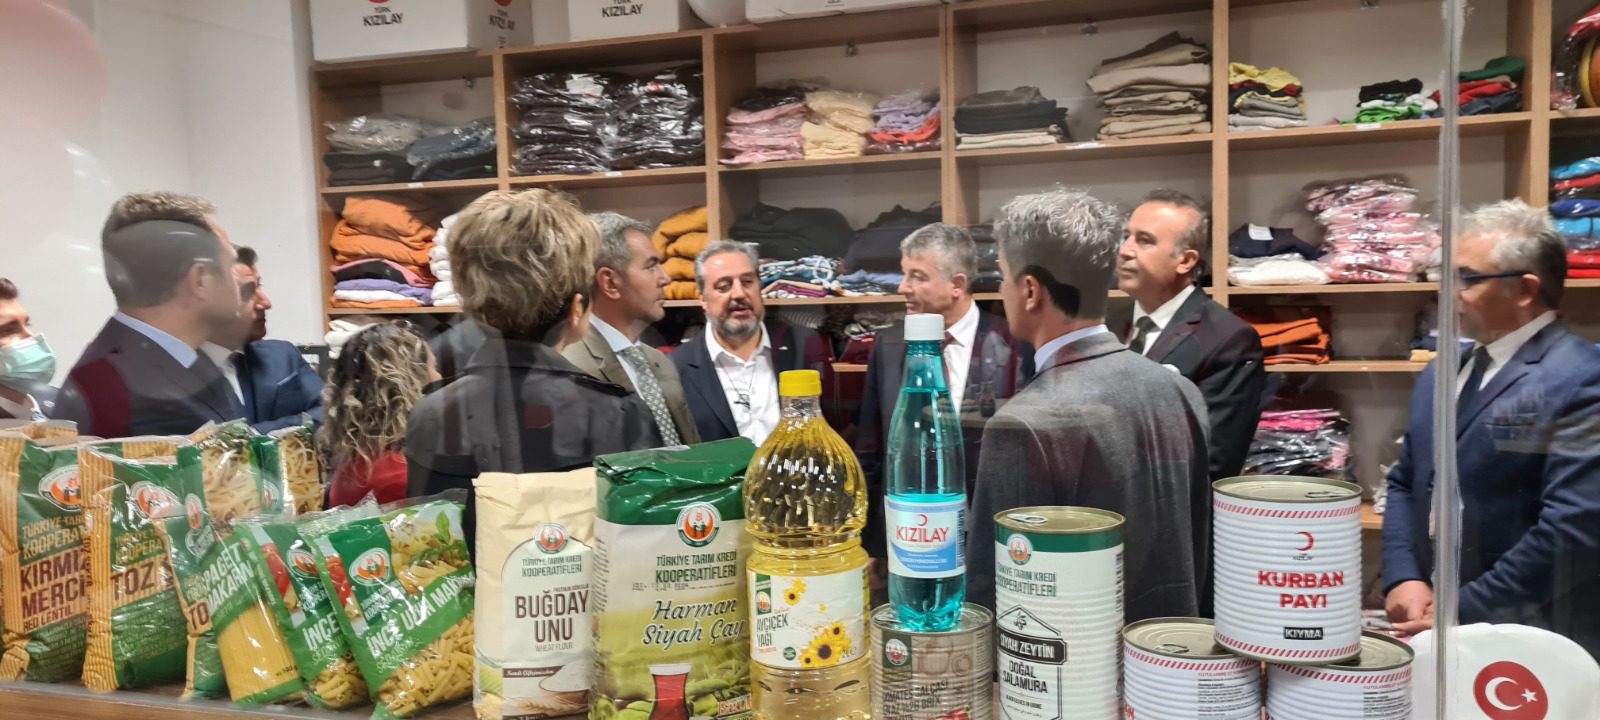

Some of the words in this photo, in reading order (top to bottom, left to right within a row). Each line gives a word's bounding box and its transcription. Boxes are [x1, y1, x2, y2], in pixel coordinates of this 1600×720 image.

[362, 13, 403, 26] KIZILAY
[601, 4, 644, 17] KIZILAY
[896, 526, 949, 542] KIZILAY
[656, 554, 690, 566] TÜRKİYE
[691, 553, 715, 565] TARIM
[110, 560, 155, 601] TOZ
[655, 563, 736, 583] KOOPERATİFLERİ
[1258, 570, 1344, 588] KURBAN
[515, 589, 589, 619] BUĞDAY
[652, 599, 737, 620] Harman
[1280, 593, 1327, 608] PAYI
[23, 619, 39, 632] RED
[535, 617, 573, 643] UNU
[643, 620, 703, 650] Siyah
[710, 619, 745, 644] Çay
[1285, 629, 1322, 638] KIYMA
[1019, 641, 1055, 658] ZEYTİN
[1009, 660, 1037, 679] DOĞAL
[1002, 670, 1048, 693] SALAMURA
